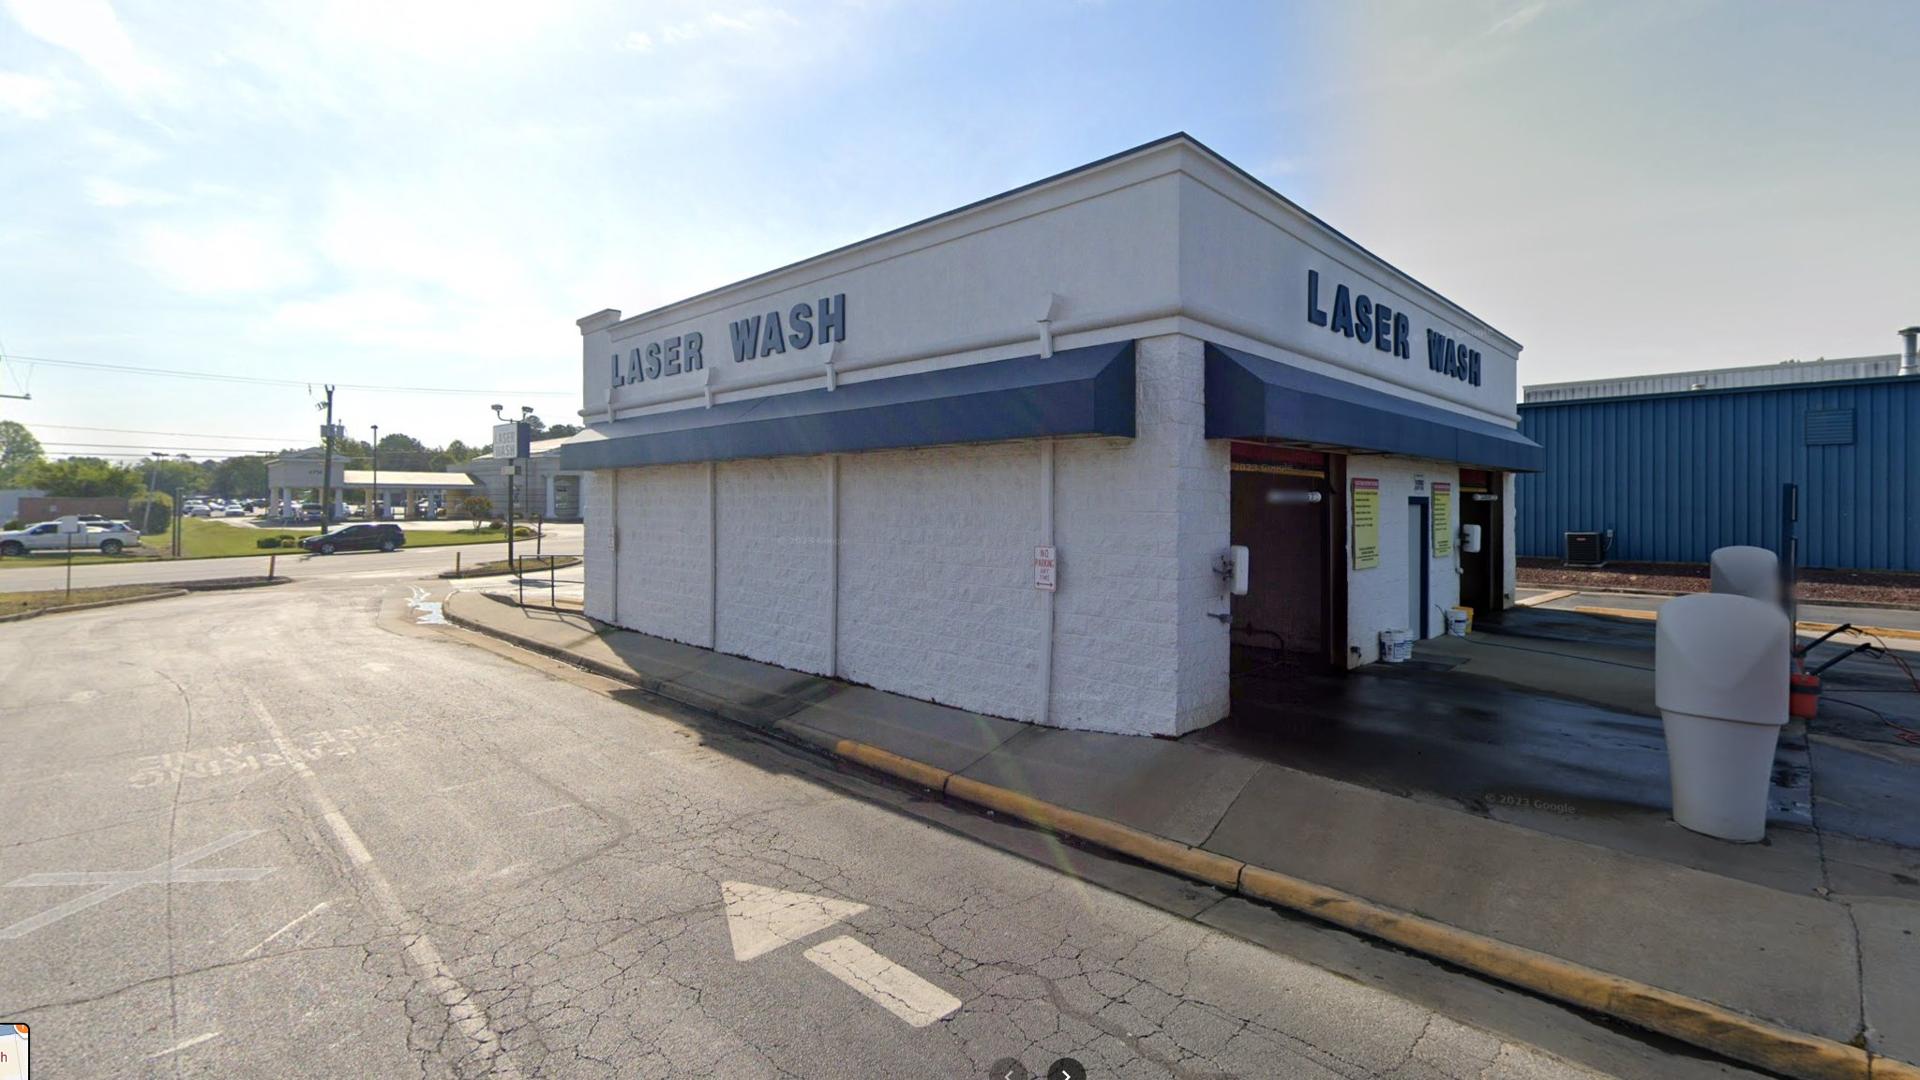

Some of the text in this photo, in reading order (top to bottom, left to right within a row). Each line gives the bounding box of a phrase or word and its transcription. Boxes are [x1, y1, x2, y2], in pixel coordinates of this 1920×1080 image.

[611, 293, 846, 389] LASER WASH
[1307, 269, 1482, 387] LASER WASH
